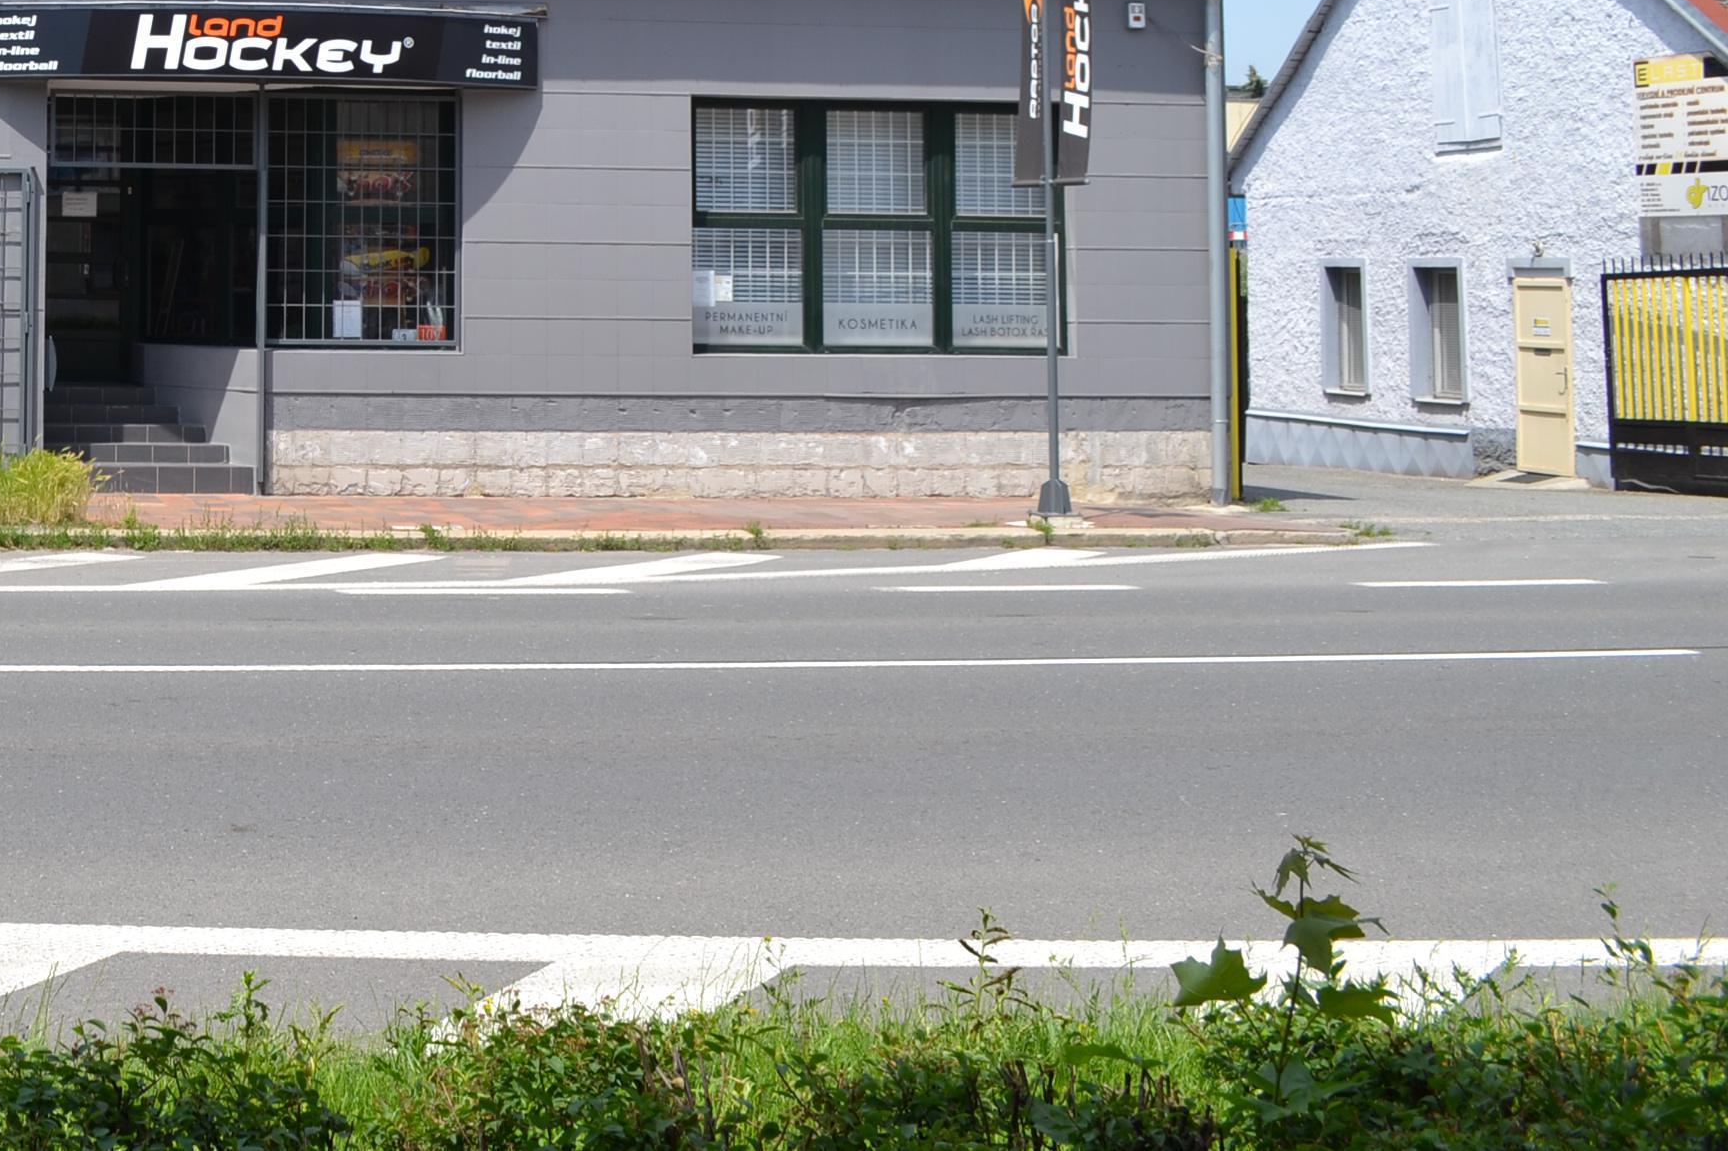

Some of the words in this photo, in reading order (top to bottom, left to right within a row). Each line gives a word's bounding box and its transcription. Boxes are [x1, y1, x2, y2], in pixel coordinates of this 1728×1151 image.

[484, 24, 521, 37] hokej
[485, 39, 521, 50] textil
[481, 54, 522, 65] in-line
[465, 68, 522, 80] floorball
[705, 310, 788, 322] PERMANENTNÍ
[973, 314, 998, 324] LASH
[1001, 314, 1039, 325] LIFTING
[719, 325, 773, 335] MAKE-UP
[838, 318, 918, 331] KOSMETIKA
[962, 327, 987, 336] LASH
[990, 328, 1027, 337] BOTOX
